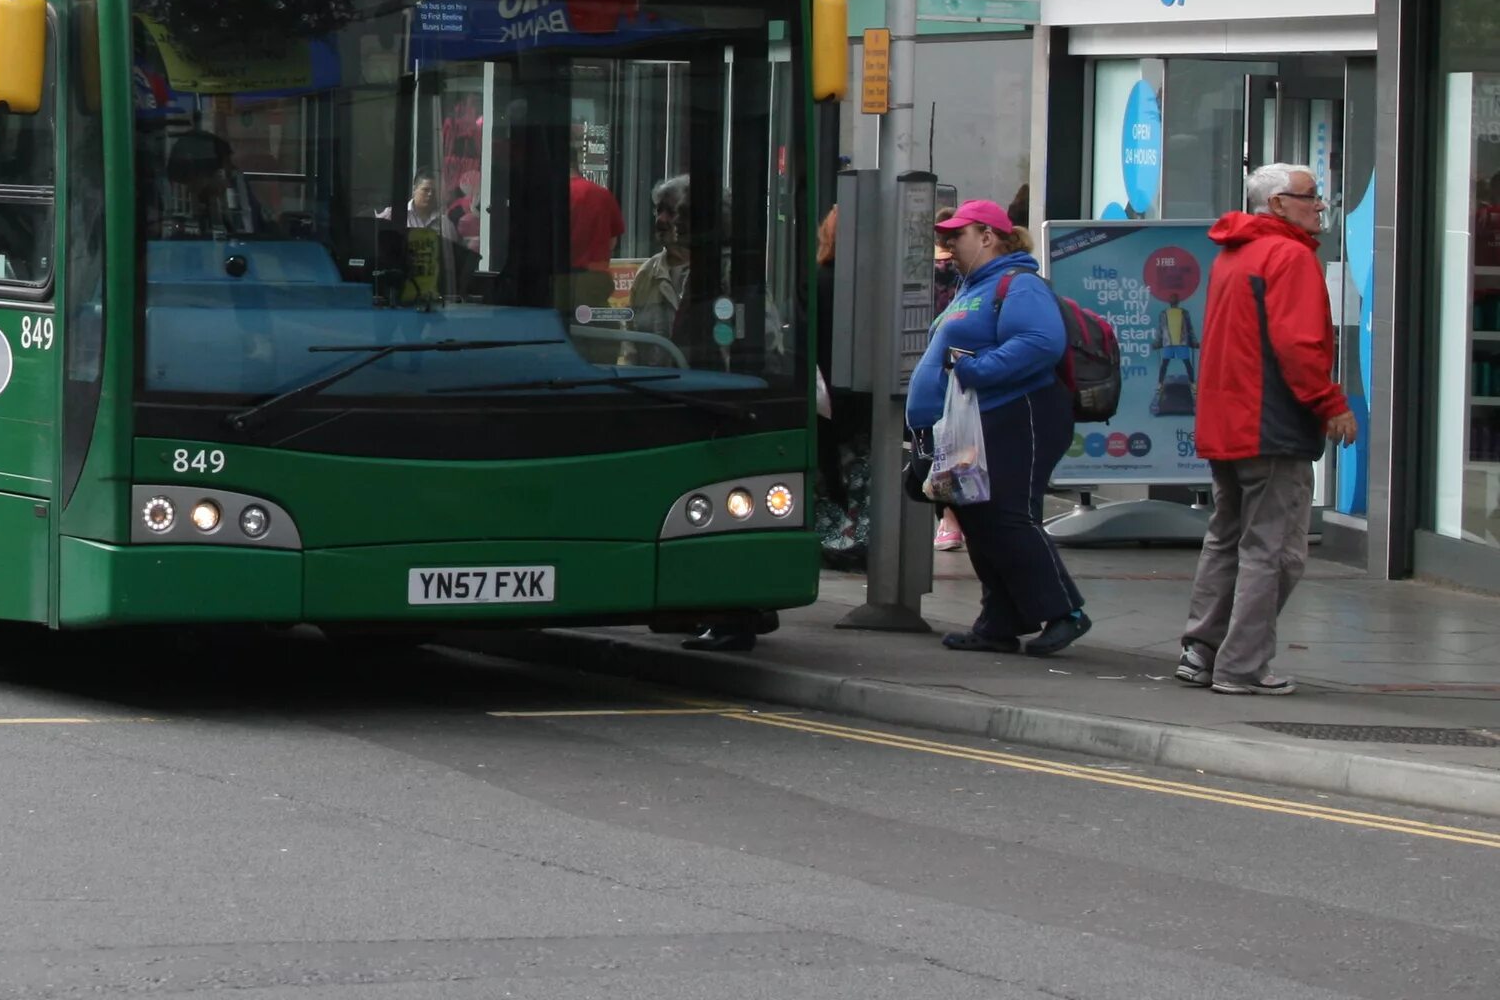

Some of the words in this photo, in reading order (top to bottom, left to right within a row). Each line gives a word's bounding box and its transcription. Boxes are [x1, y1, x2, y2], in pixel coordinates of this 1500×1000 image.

[1132, 123, 1151, 140] OPEN
[1125, 148, 1133, 164] 24
[1134, 149, 1157, 166] HOURS
[1161, 257, 1175, 266] FREE
[1092, 265, 1118, 279] the
[1083, 276, 1118, 290] time
[1122, 277, 1138, 289] to
[1097, 289, 1124, 305] get
[1129, 285, 1151, 300] off
[1123, 300, 1150, 312] my
[20, 315, 54, 350] 849
[1120, 328, 1157, 340] start
[172, 448, 226, 474] 849
[420, 571, 488, 600] YN57
[494, 570, 545, 598] FXK
